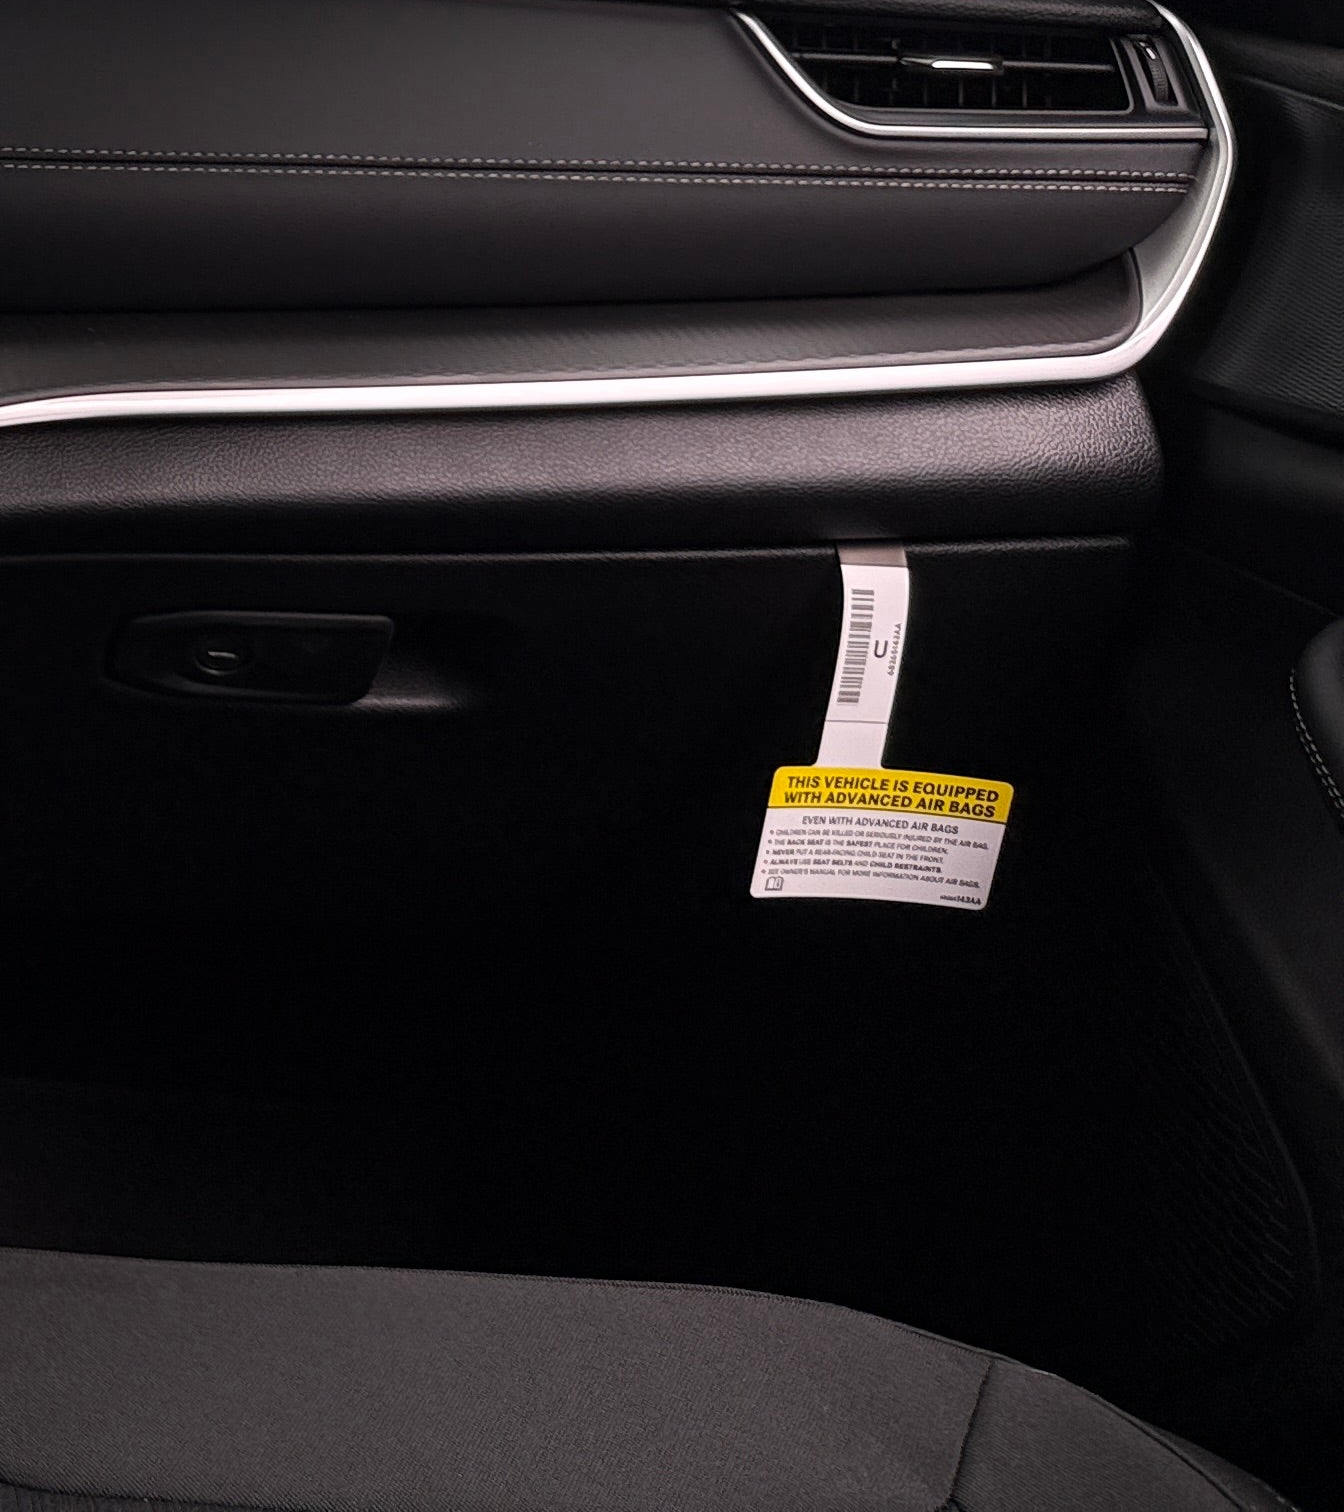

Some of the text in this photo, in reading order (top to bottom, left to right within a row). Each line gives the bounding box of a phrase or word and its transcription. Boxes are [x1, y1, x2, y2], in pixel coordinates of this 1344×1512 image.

[873, 640, 889, 659] U
[787, 776, 1000, 803] THIS VEHICLE IS EQUIPPED
[784, 792, 996, 818] WITH ADVANCED AIR BAGS
[802, 816, 959, 834] EVEN WITH ADVANCED AIR BAGS
